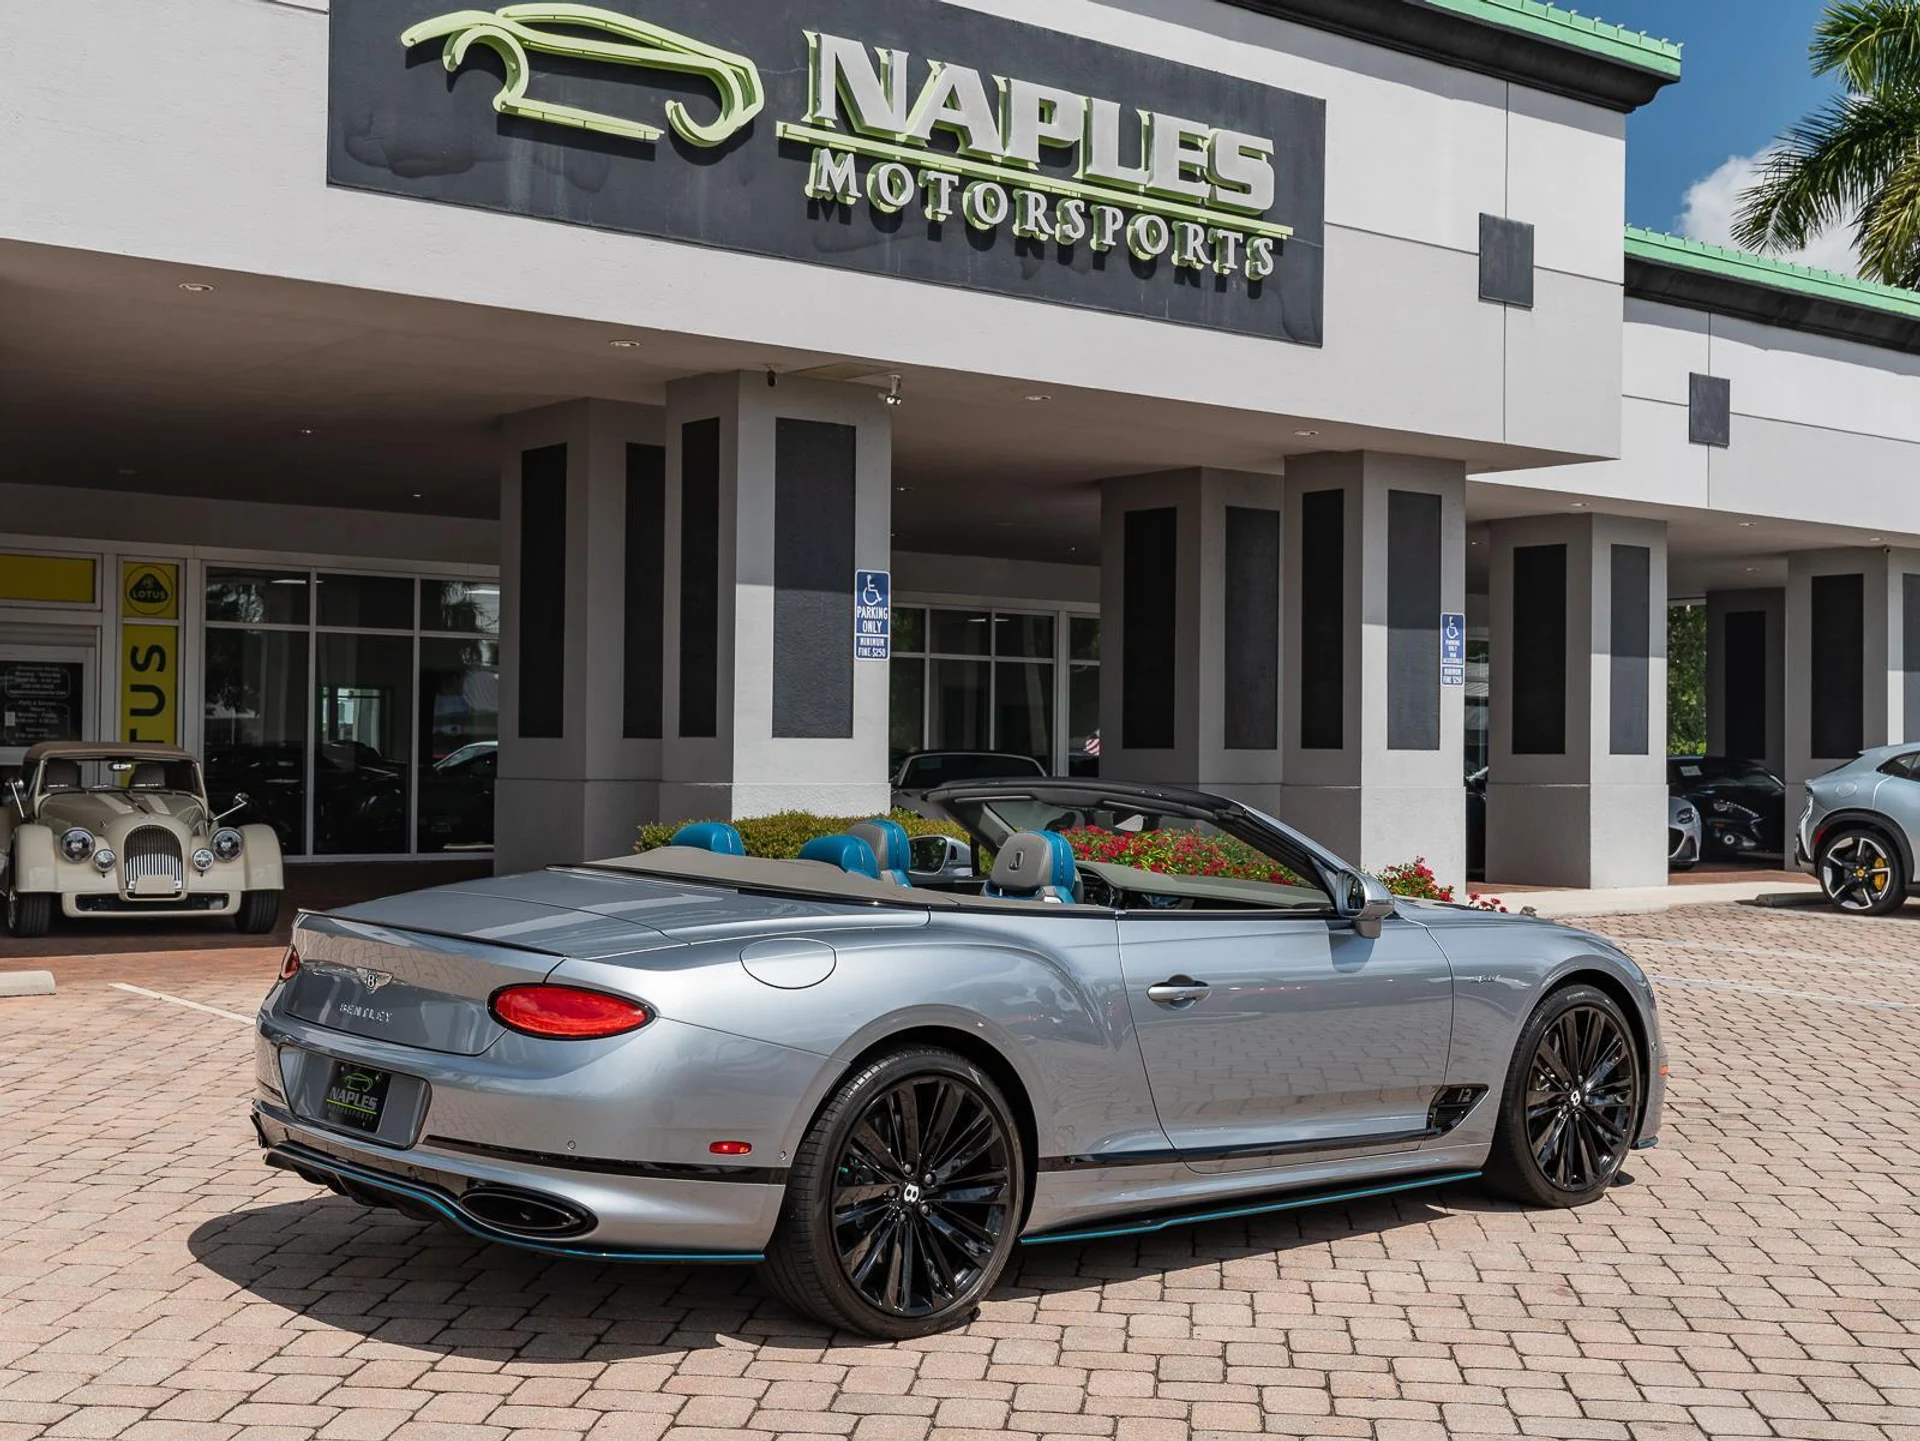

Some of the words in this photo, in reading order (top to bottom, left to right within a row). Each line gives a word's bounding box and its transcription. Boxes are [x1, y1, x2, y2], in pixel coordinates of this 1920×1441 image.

[803, 30, 1275, 214] NAPLES
[805, 148, 1274, 280] MOTORSPORTS
[132, 589, 166, 600] LOTUS
[857, 606, 888, 620] PARKING
[862, 620, 882, 633] ONLY
[858, 647, 871, 657] FINE
[872, 647, 886, 658] $250
[130, 645, 166, 743] TUS
[339, 1002, 394, 1023] BENTLEY
[329, 1086, 378, 1110] NAPLES
